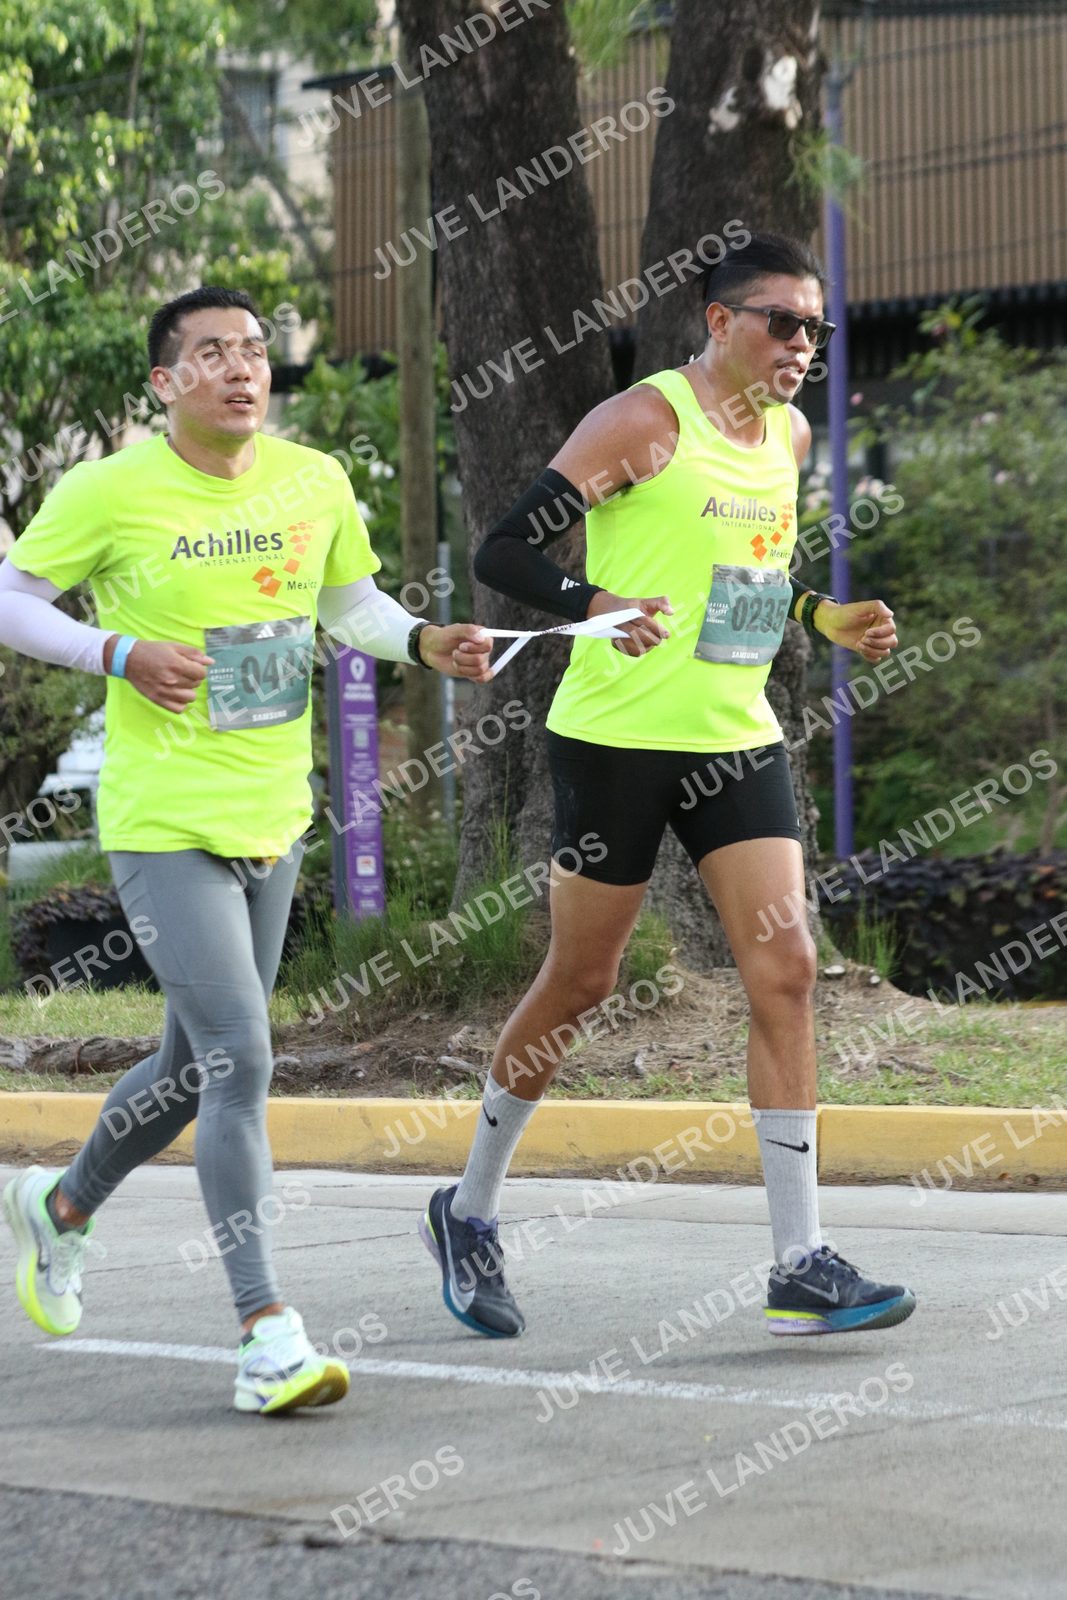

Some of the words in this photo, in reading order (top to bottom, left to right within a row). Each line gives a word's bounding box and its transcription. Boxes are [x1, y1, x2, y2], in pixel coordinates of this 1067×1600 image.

[700, 496, 776, 523] Achilles
[170, 528, 284, 560] Achilles
[200, 553, 285, 568] INTERNATIONAL
[731, 595, 788, 633] 0235
